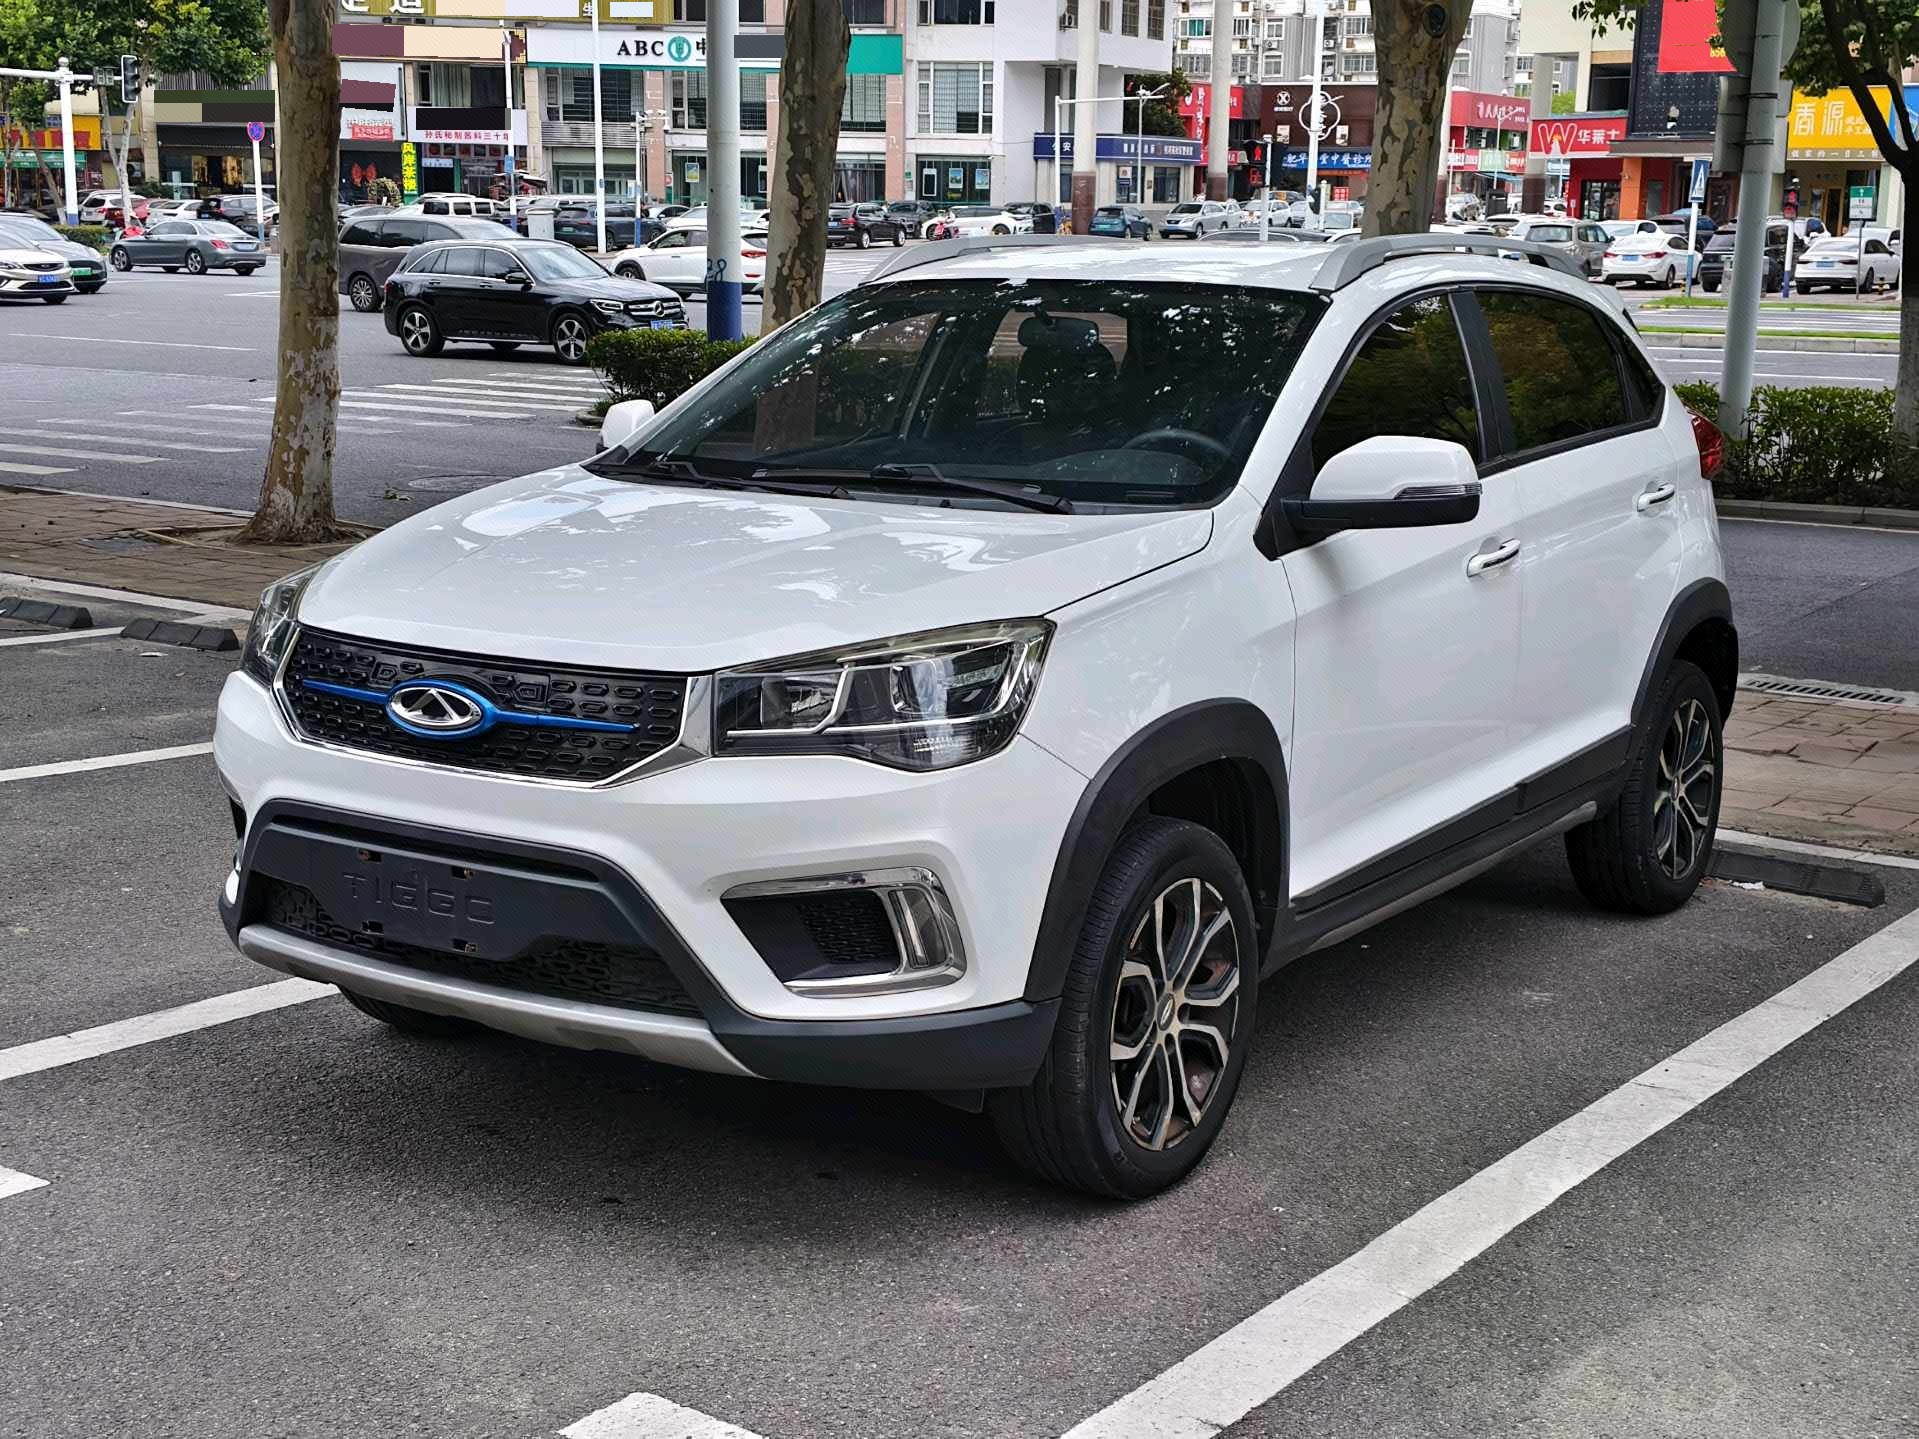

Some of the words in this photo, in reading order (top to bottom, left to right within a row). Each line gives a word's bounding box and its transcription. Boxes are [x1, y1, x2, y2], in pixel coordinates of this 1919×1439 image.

[617, 39, 664, 56] ABC
[1793, 101, 1845, 136] 香源
[1577, 128, 1620, 145] 华莱士
[343, 873, 496, 926] TIGGO
